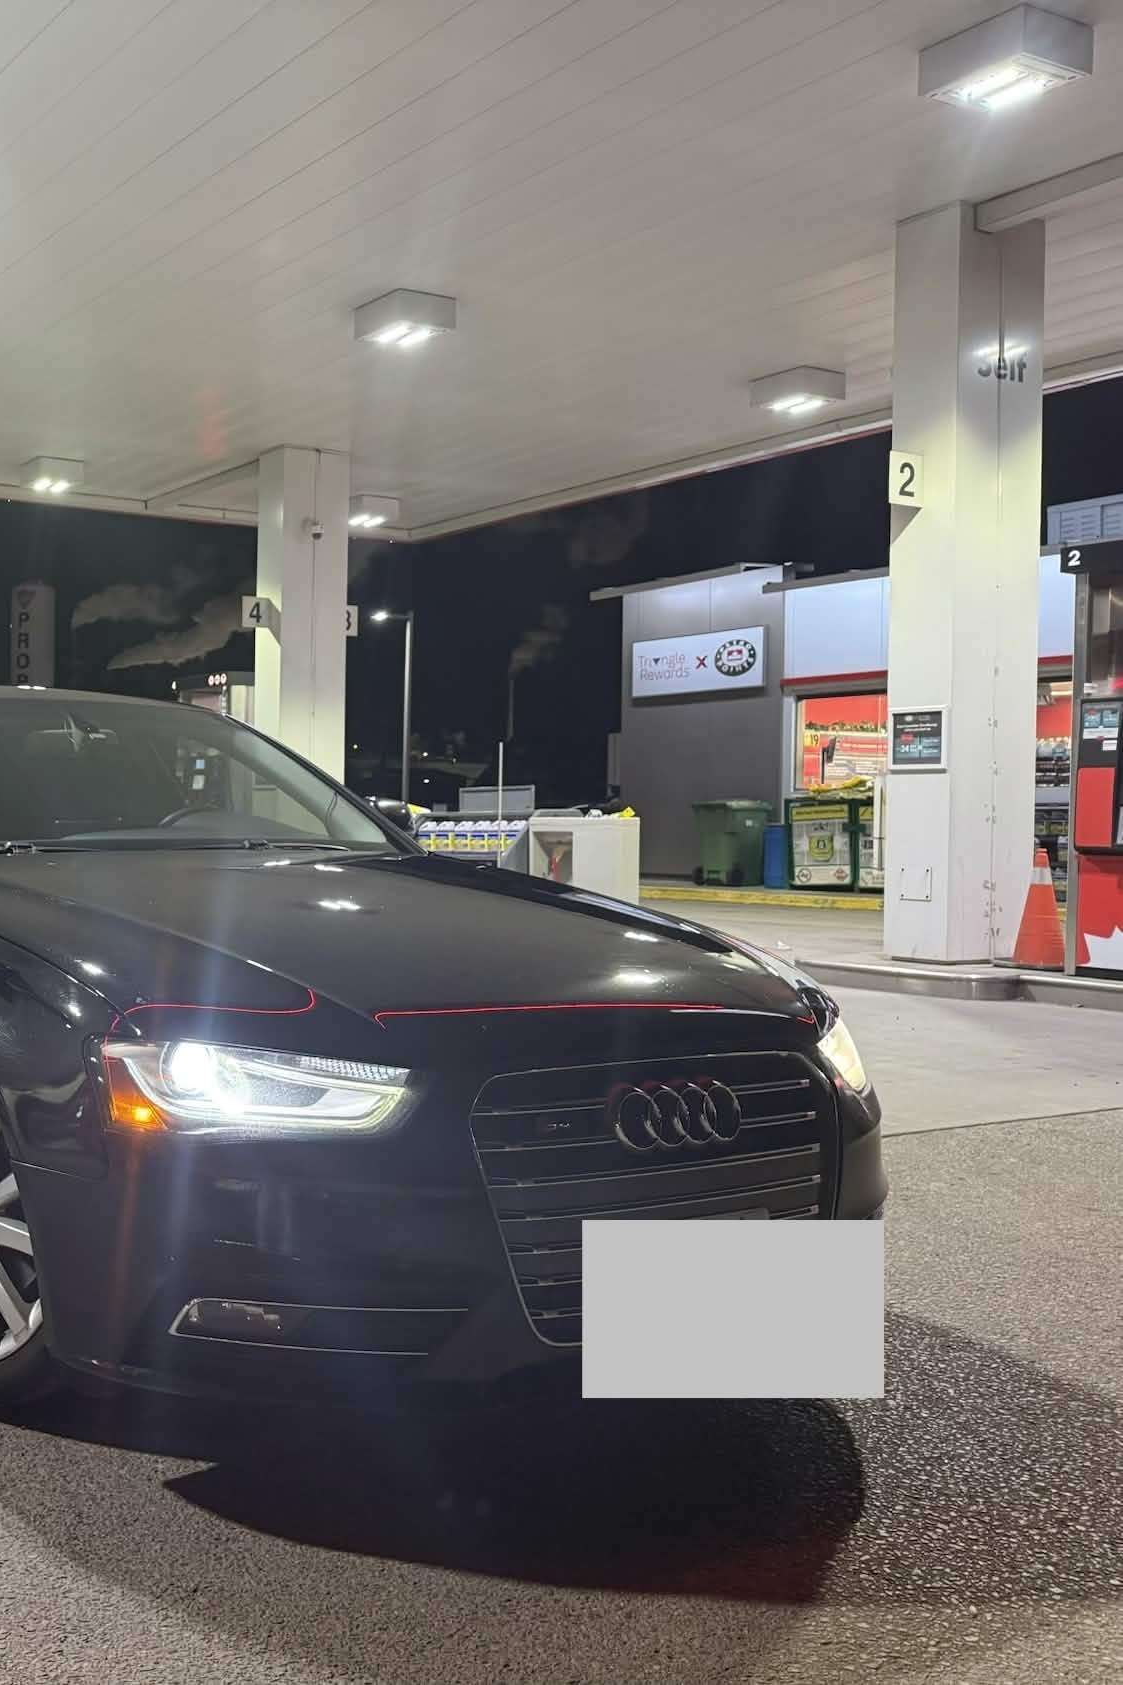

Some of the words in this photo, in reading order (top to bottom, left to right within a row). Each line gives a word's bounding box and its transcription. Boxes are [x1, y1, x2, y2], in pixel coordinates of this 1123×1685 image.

[898, 462, 915, 497] 2
[1067, 550, 1081, 566] 2
[249, 602, 262, 623] 4
